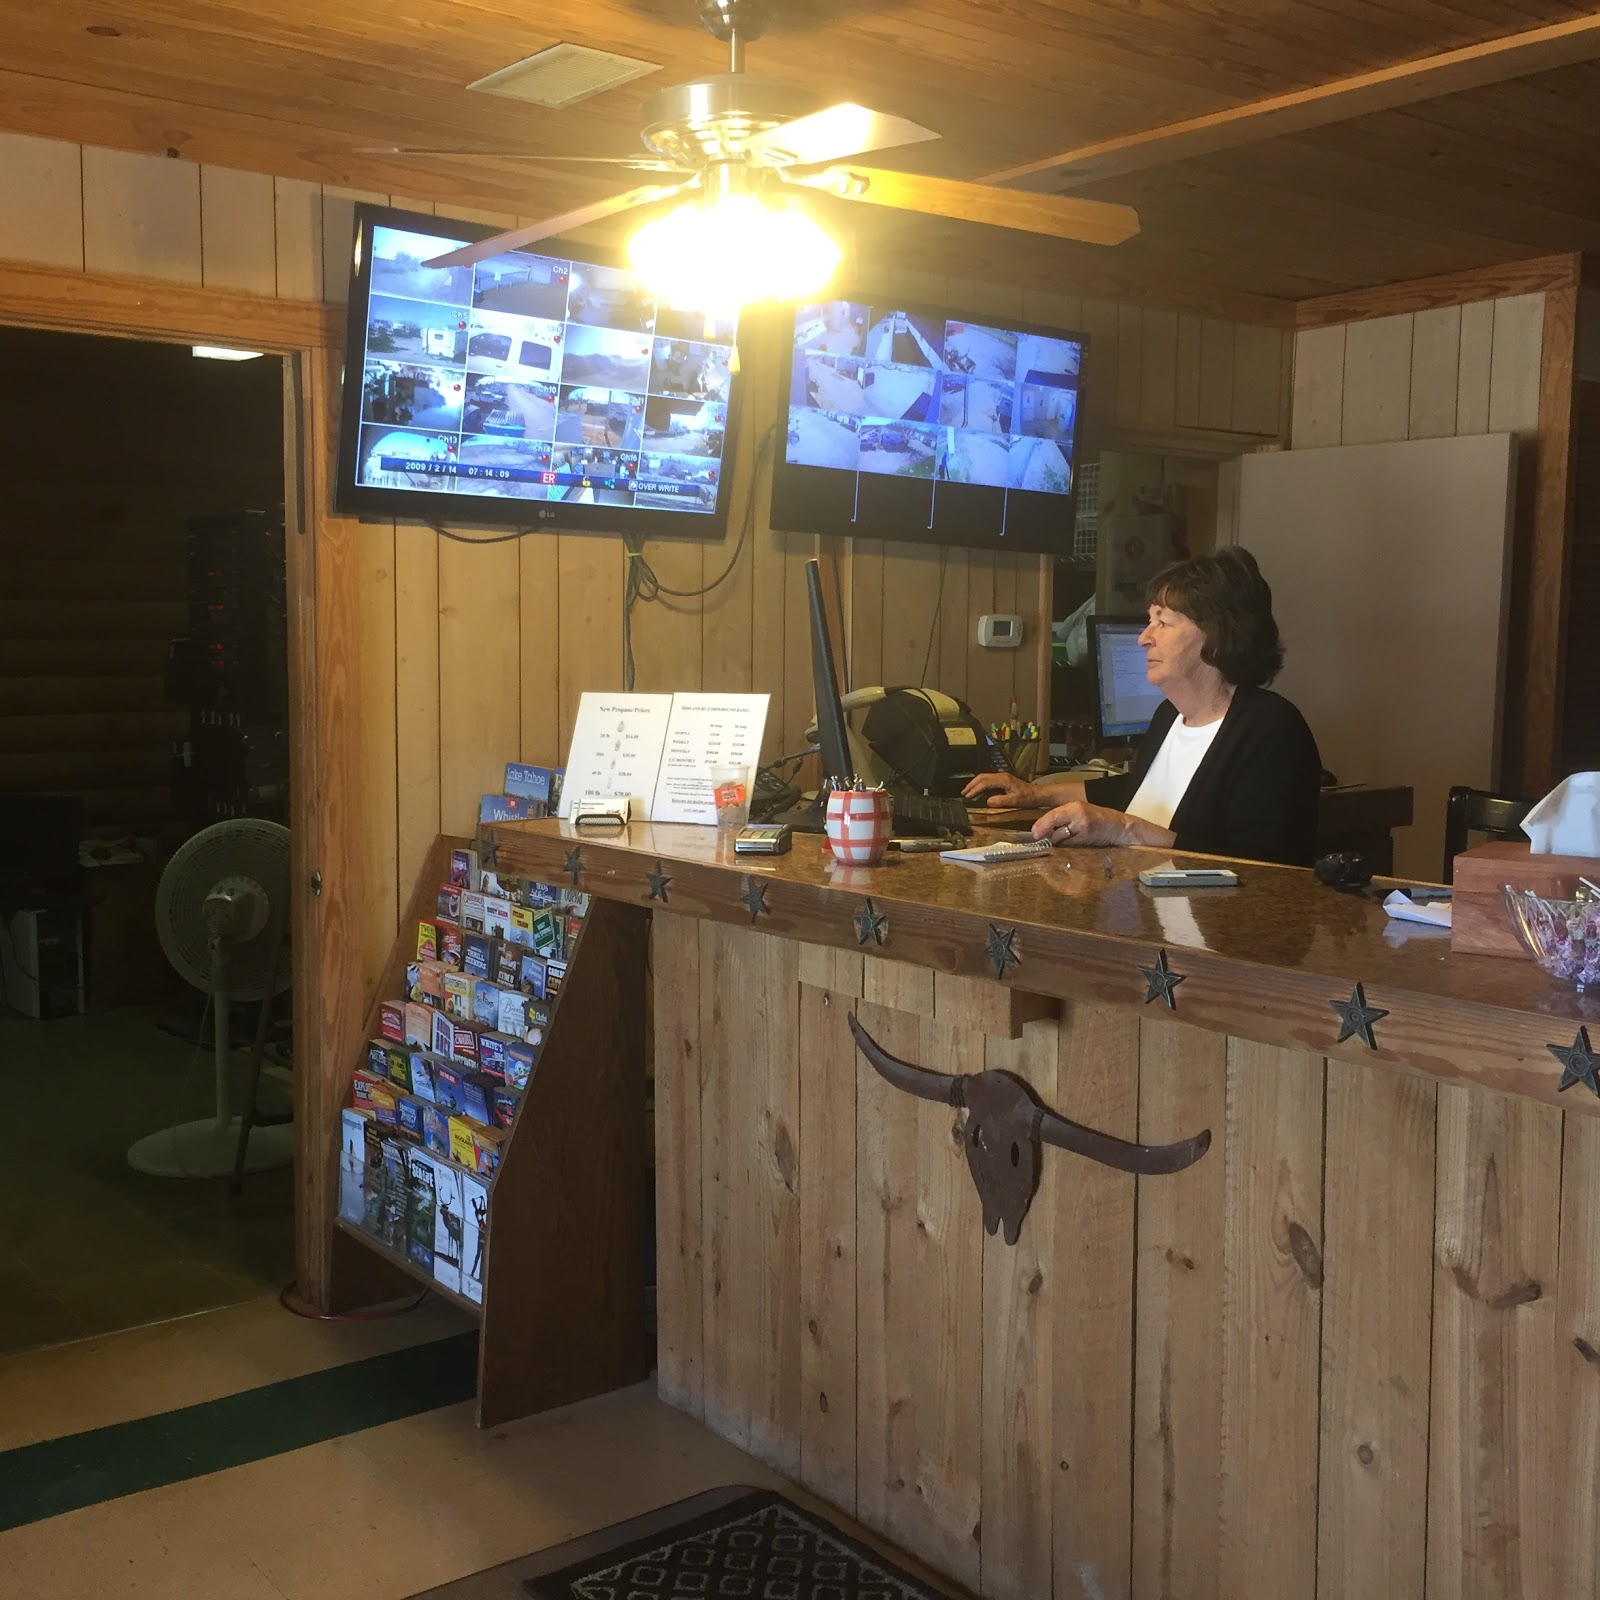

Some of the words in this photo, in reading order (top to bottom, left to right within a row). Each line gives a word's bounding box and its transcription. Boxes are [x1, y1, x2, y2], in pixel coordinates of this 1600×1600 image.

[552, 265, 569, 275] Ch2
[451, 310, 468, 319] Ch5
[538, 384, 557, 395] Ch10
[437, 435, 458, 444] Ch13
[542, 473, 556, 484] ER
[638, 483, 657, 491] OVER
[658, 484, 679, 493] WRITE
[611, 706, 633, 714] Propane
[506, 767, 523, 782] Lake
[524, 770, 546, 786] Tahoe
[480, 1037, 504, 1052] WHITE'S
